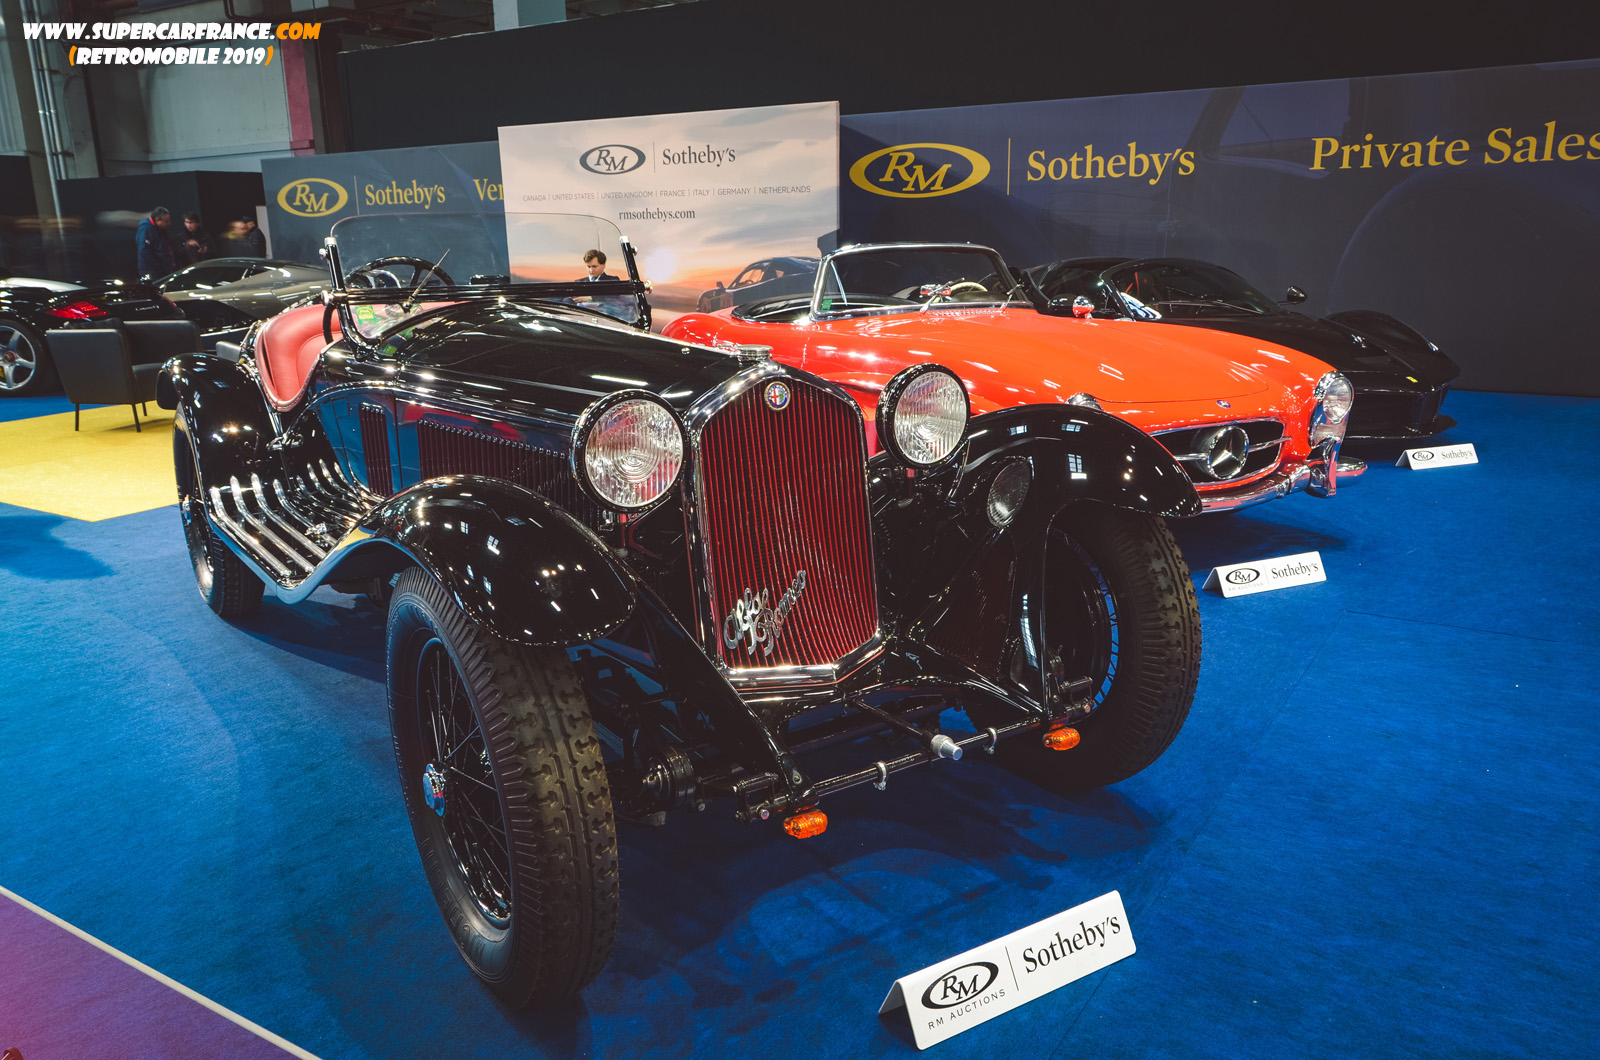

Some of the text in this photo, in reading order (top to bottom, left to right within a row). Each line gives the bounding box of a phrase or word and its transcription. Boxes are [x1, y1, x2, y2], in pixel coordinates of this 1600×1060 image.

[594, 144, 736, 171] RM Sotheby's
[1309, 121, 1600, 170] Private Sales
[879, 141, 1195, 191] RM Sotheby's
[293, 180, 446, 212] RM Sotheby's
[624, 191, 653, 199] KINGDOM
[660, 190, 686, 198] FRANCE
[717, 188, 751, 196] GERMANY
[758, 185, 811, 195] NETHERLANDS
[619, 207, 696, 221] rmsothebys.com
[1441, 449, 1473, 460] Sotheby's
[1271, 562, 1319, 580] Sotheby's
[940, 916, 1121, 1001] RM Sotheby's
[928, 988, 1006, 1030] RM AUCTIONS
